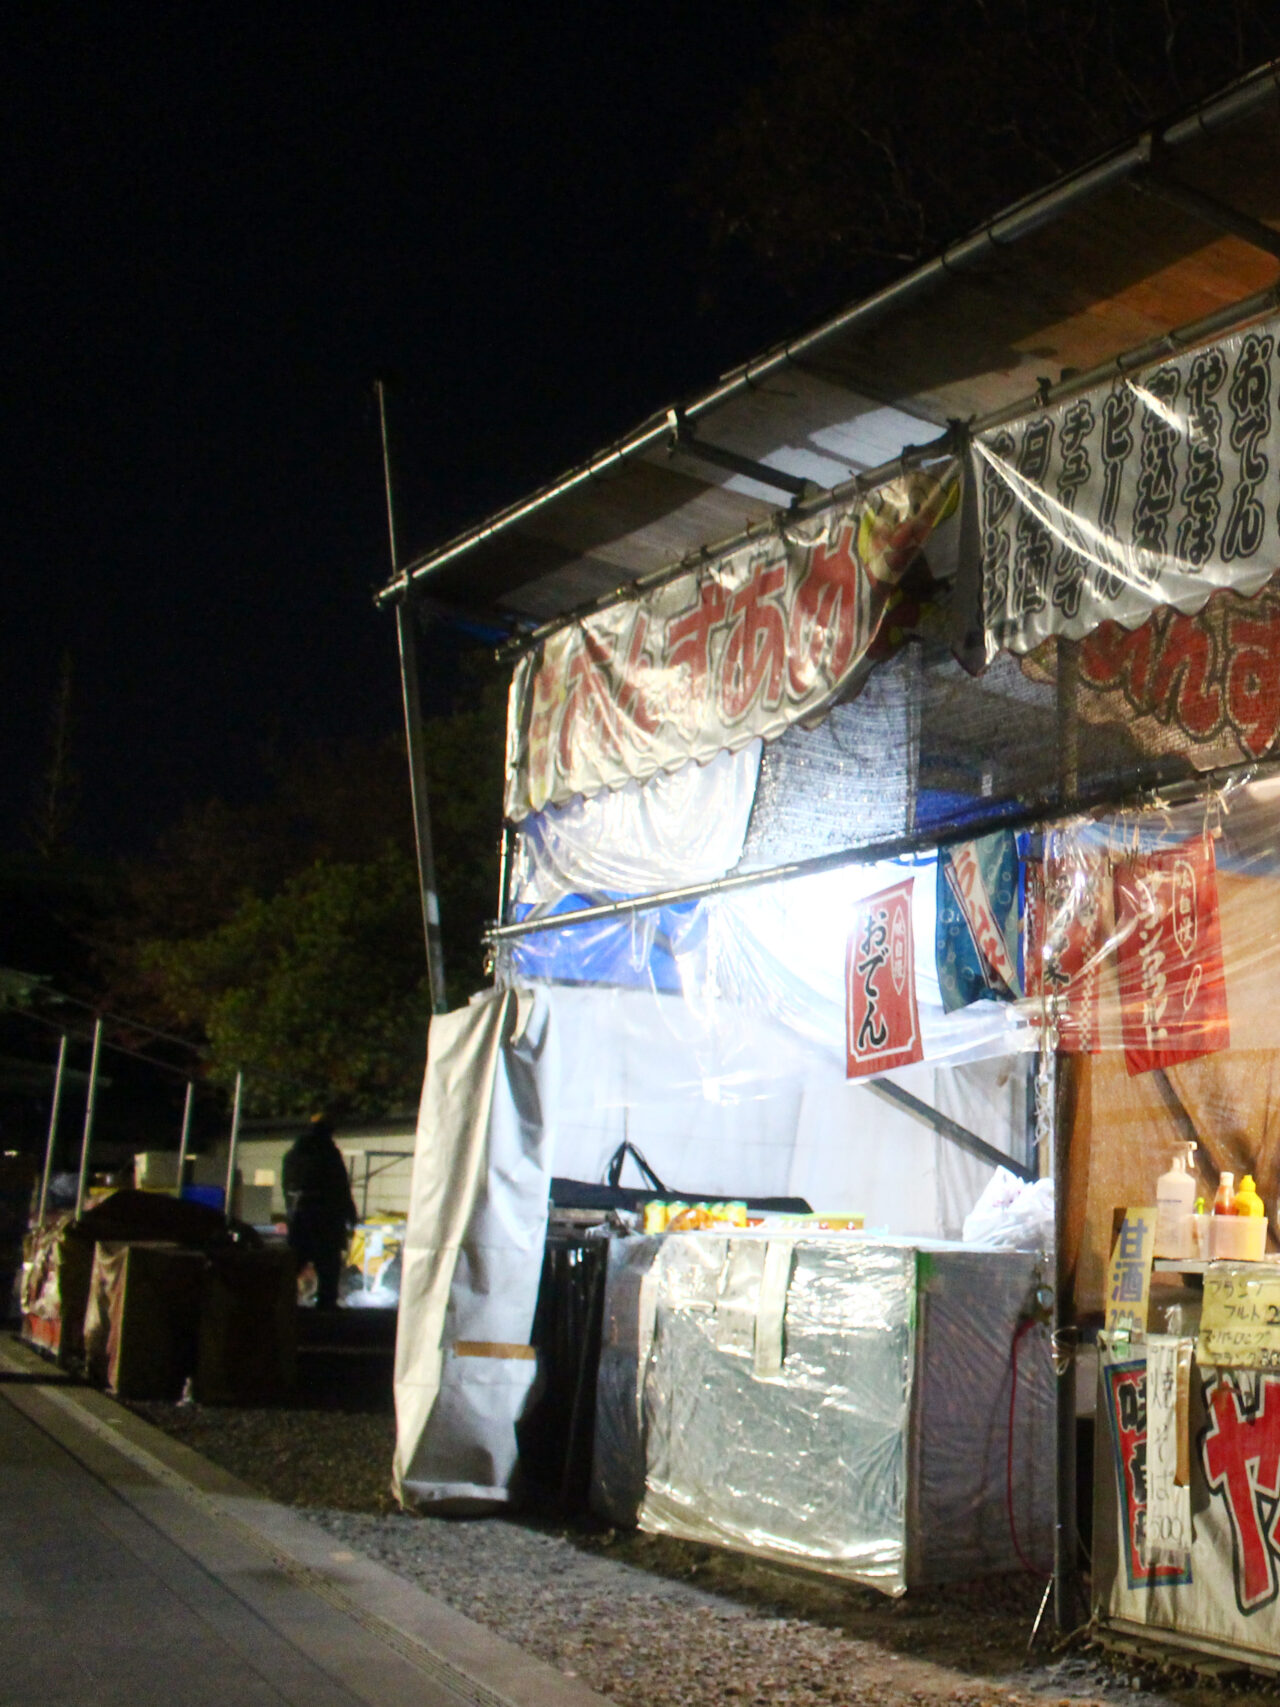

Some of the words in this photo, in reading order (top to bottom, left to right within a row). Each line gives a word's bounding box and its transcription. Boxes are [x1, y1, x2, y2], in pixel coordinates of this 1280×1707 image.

[1175, 348, 1228, 575] やきそば
[1220, 333, 1276, 563] おでん
[856, 908, 892, 1053] おでん
[1111, 1217, 1149, 1303] 甘酒
